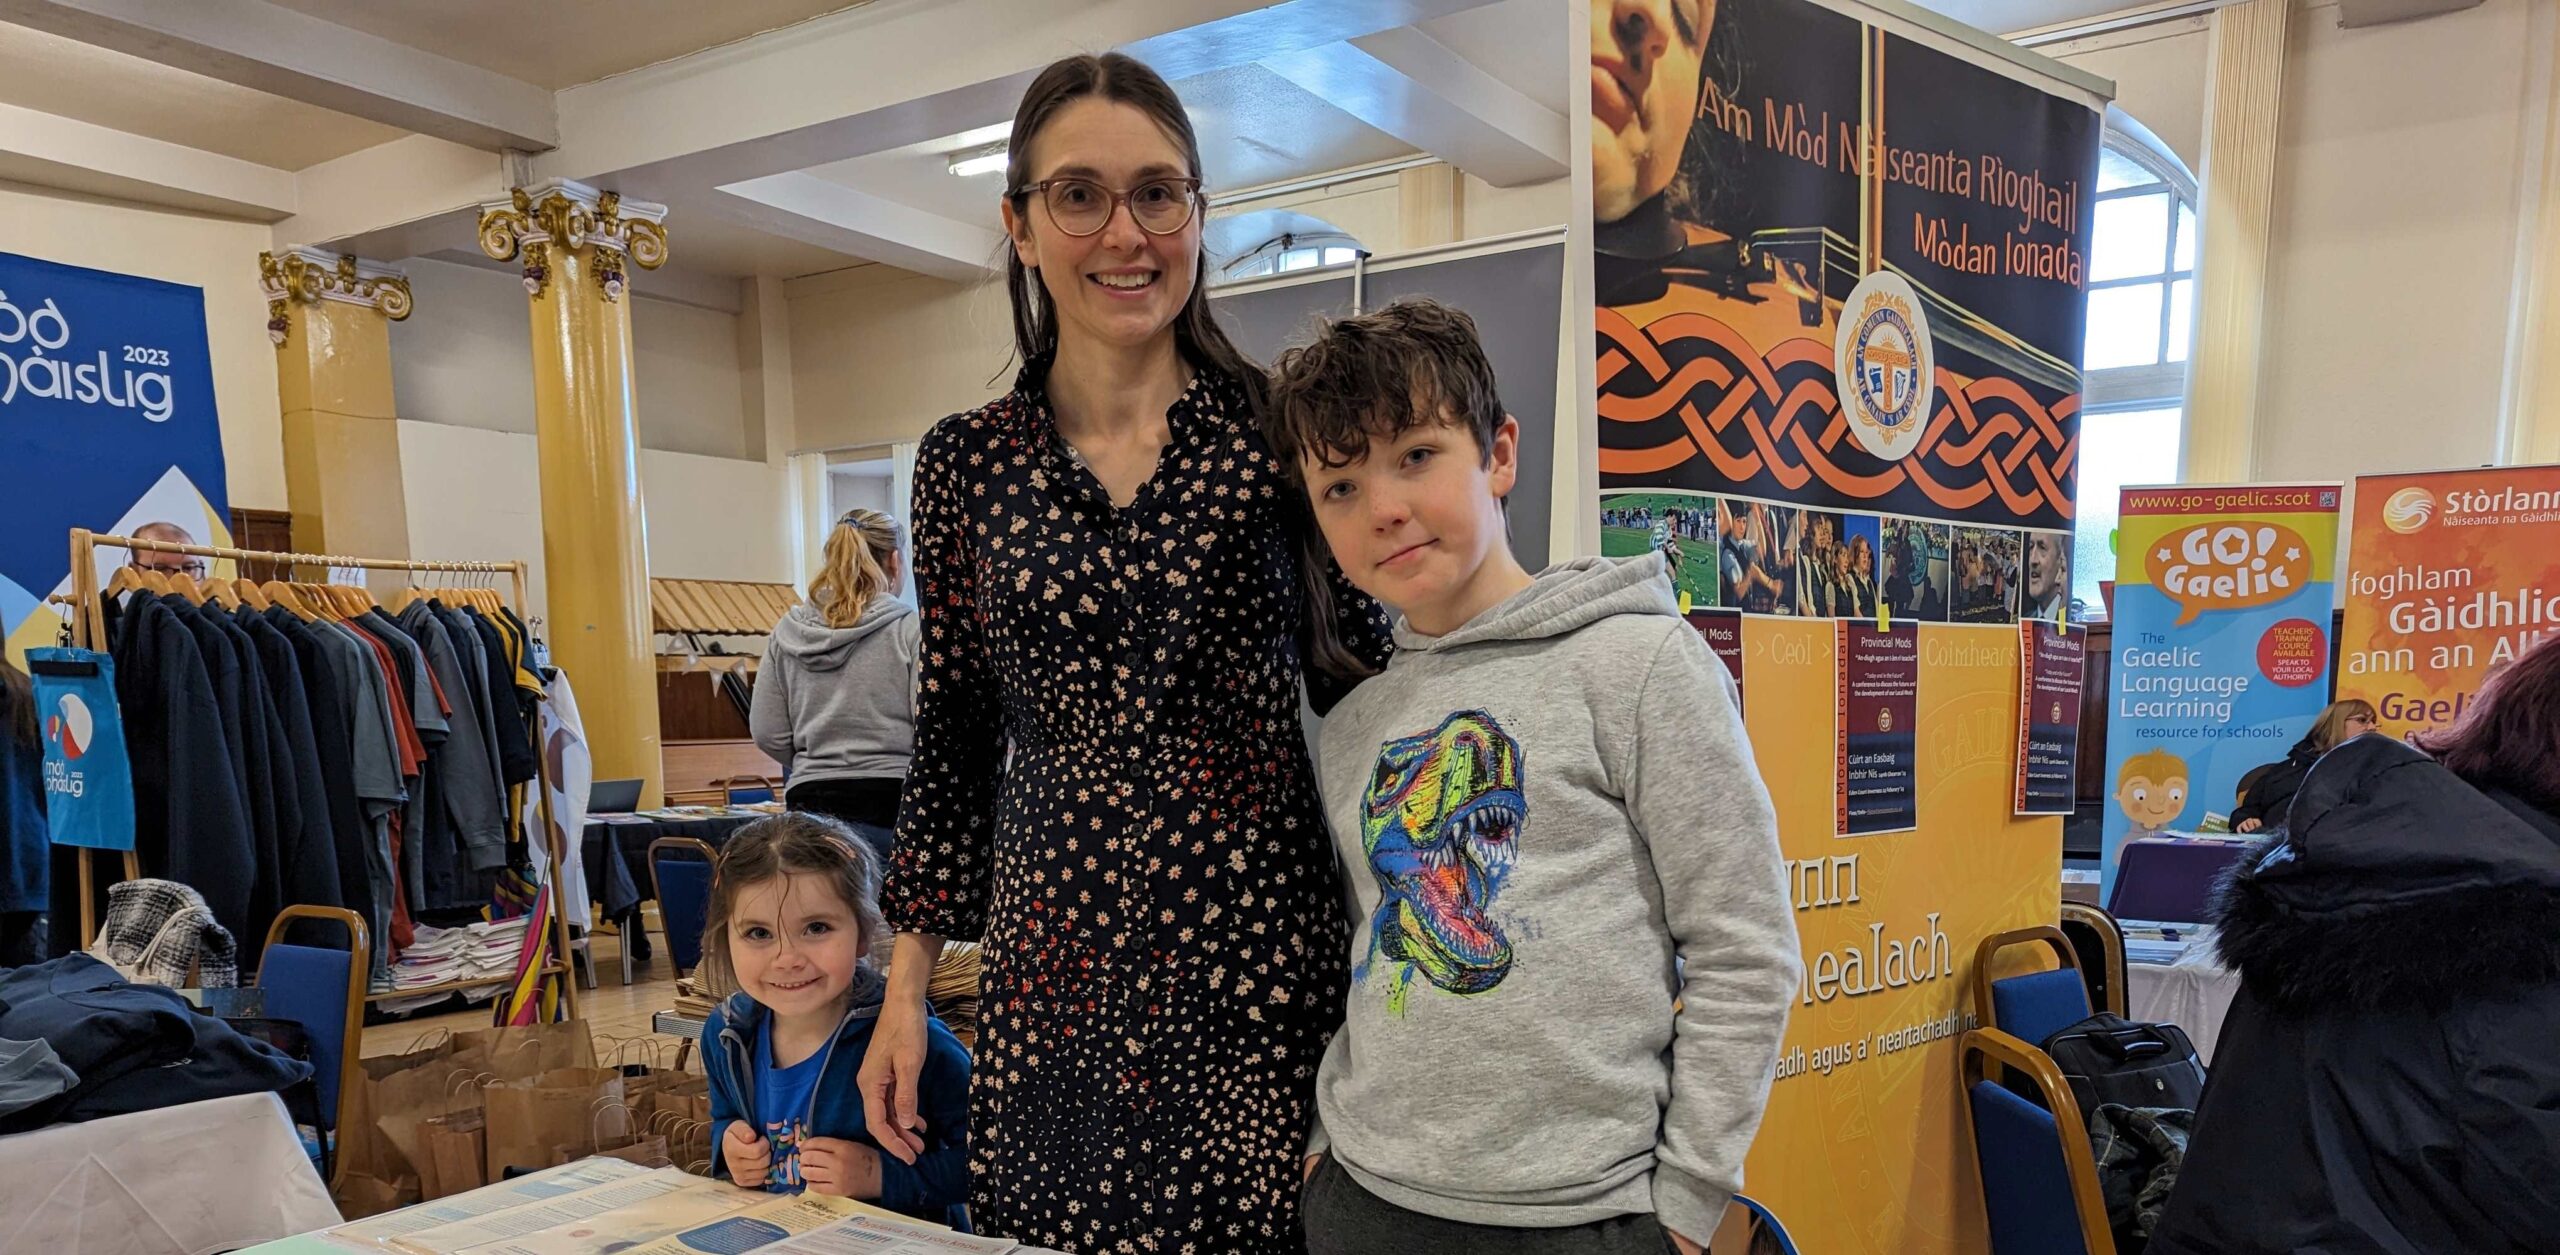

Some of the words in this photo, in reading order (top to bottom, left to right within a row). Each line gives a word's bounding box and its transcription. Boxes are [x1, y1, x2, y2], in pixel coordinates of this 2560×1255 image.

[1697, 76, 1752, 142] Am
[1765, 97, 1827, 169] Mòd
[1839, 121, 1972, 199] Nàiseanta
[1980, 155, 2077, 235] Rìoghail
[1915, 212, 1996, 275] Mòdan
[0, 289, 70, 349] òd
[123, 345, 170, 367] 2023
[2129, 491, 2312, 511] www.go-gaelic.scot
[2443, 515, 2499, 527] Nàiseanta
[2502, 515, 2517, 524] na
[2520, 511, 2560, 523] Gàidhli
[2181, 526, 2278, 566] GO!
[2164, 556, 2290, 599] Gaelic
[2350, 564, 2472, 600] foghlam
[1709, 628, 1733, 640] Mods
[1861, 636, 1894, 649] Provincial
[1895, 637, 1912, 649] Mods
[2140, 633, 2166, 645] The
[2122, 647, 2202, 667] Gaelic
[2349, 648, 2415, 675] ann
[2430, 644, 2473, 670] an
[2121, 672, 2249, 698] Language
[2120, 698, 2231, 723] Learning
[2380, 692, 2475, 723] Gael
[2136, 730, 2198, 738] resource
[2202, 725, 2222, 738] for
[2226, 724, 2284, 738] schools
[1865, 755, 1872, 764] an
[1873, 752, 1895, 765] Easbaig
[1773, 1044, 1806, 1081] adh
[1812, 1042, 1851, 1075] agus
[1877, 1009, 1959, 1056] neartachadh
